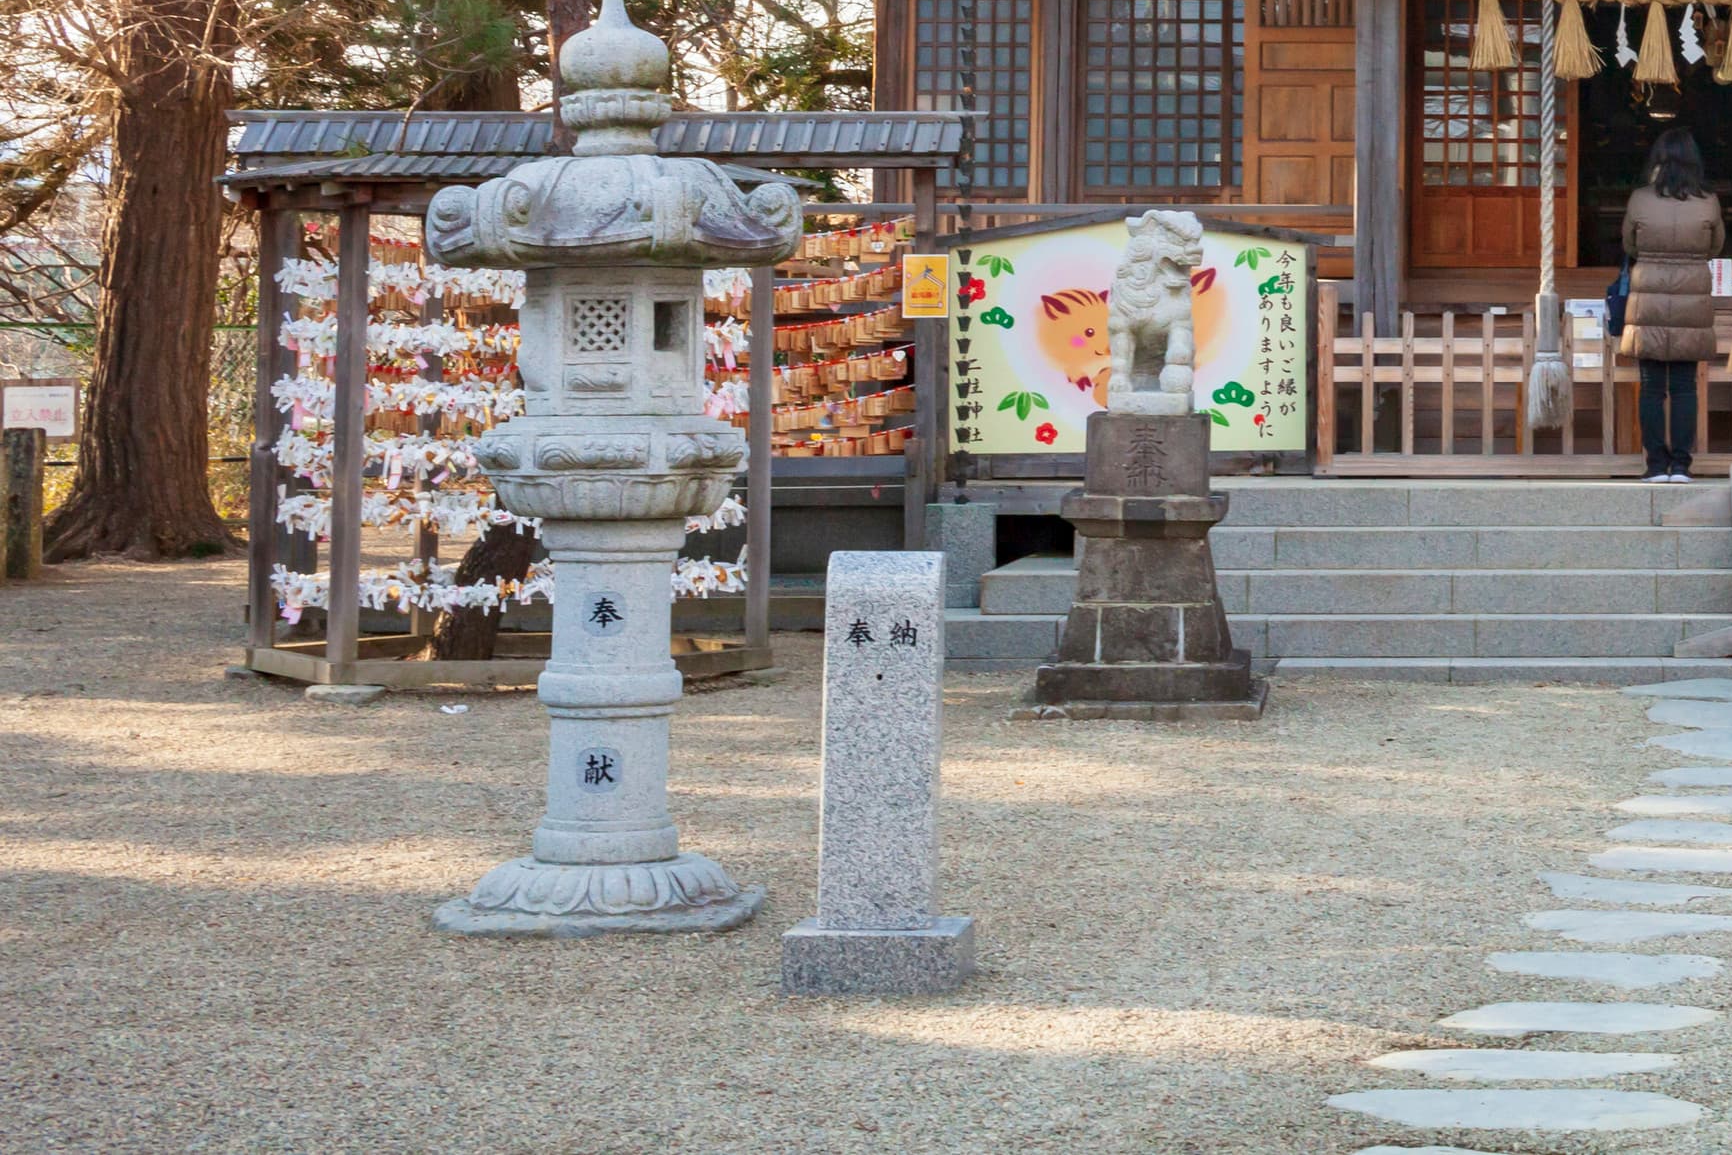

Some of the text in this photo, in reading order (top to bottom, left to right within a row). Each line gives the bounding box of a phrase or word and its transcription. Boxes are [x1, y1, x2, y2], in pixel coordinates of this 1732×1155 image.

[1258, 295, 1274, 438] ありますように
[1276, 250, 1297, 417] 今年も良いご縁が
[1124, 423, 1170, 488] 奉納
[844, 618, 919, 648] 奉納
